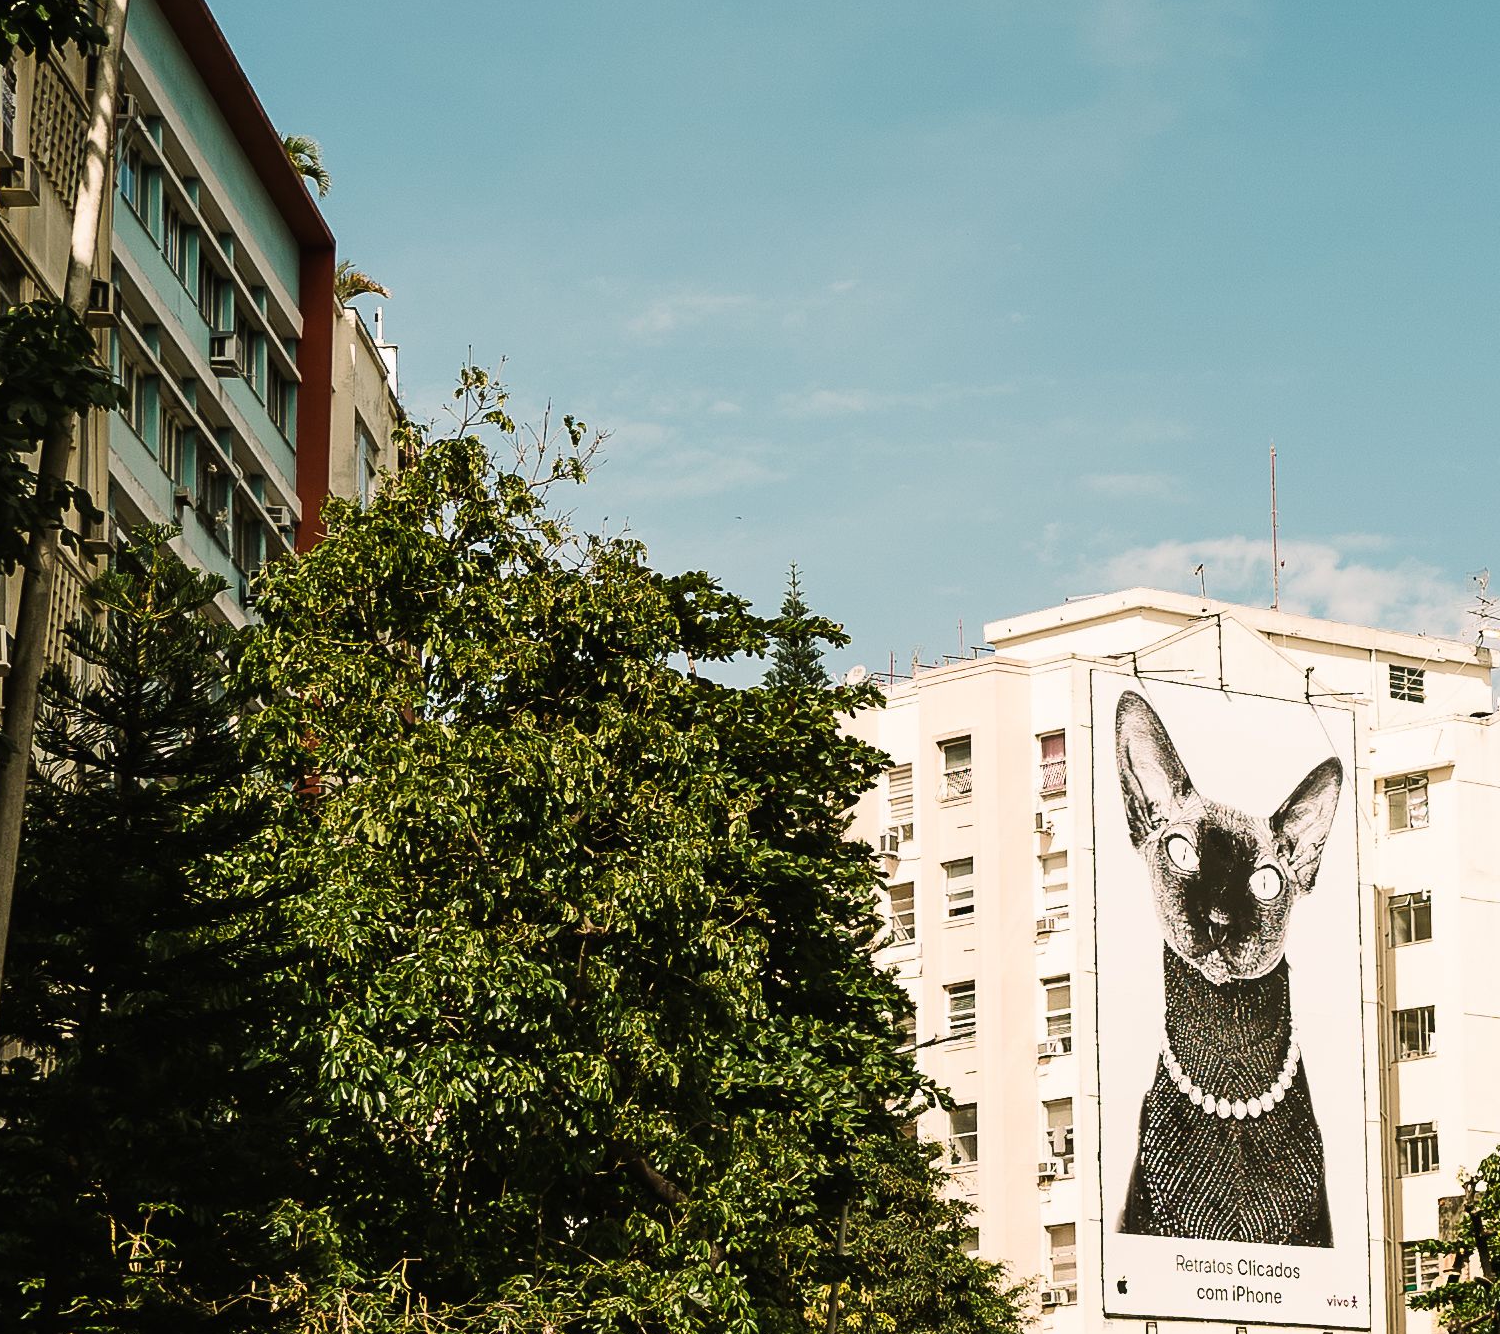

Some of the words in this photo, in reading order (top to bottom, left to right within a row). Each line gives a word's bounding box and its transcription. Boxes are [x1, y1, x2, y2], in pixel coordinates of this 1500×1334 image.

[1175, 1255, 1234, 1275] Retratos
[1237, 1258, 1301, 1279] Clicados
[1196, 1286, 1228, 1302] com
[1232, 1285, 1283, 1305] iPhone
[1326, 1295, 1350, 1308] vivo
